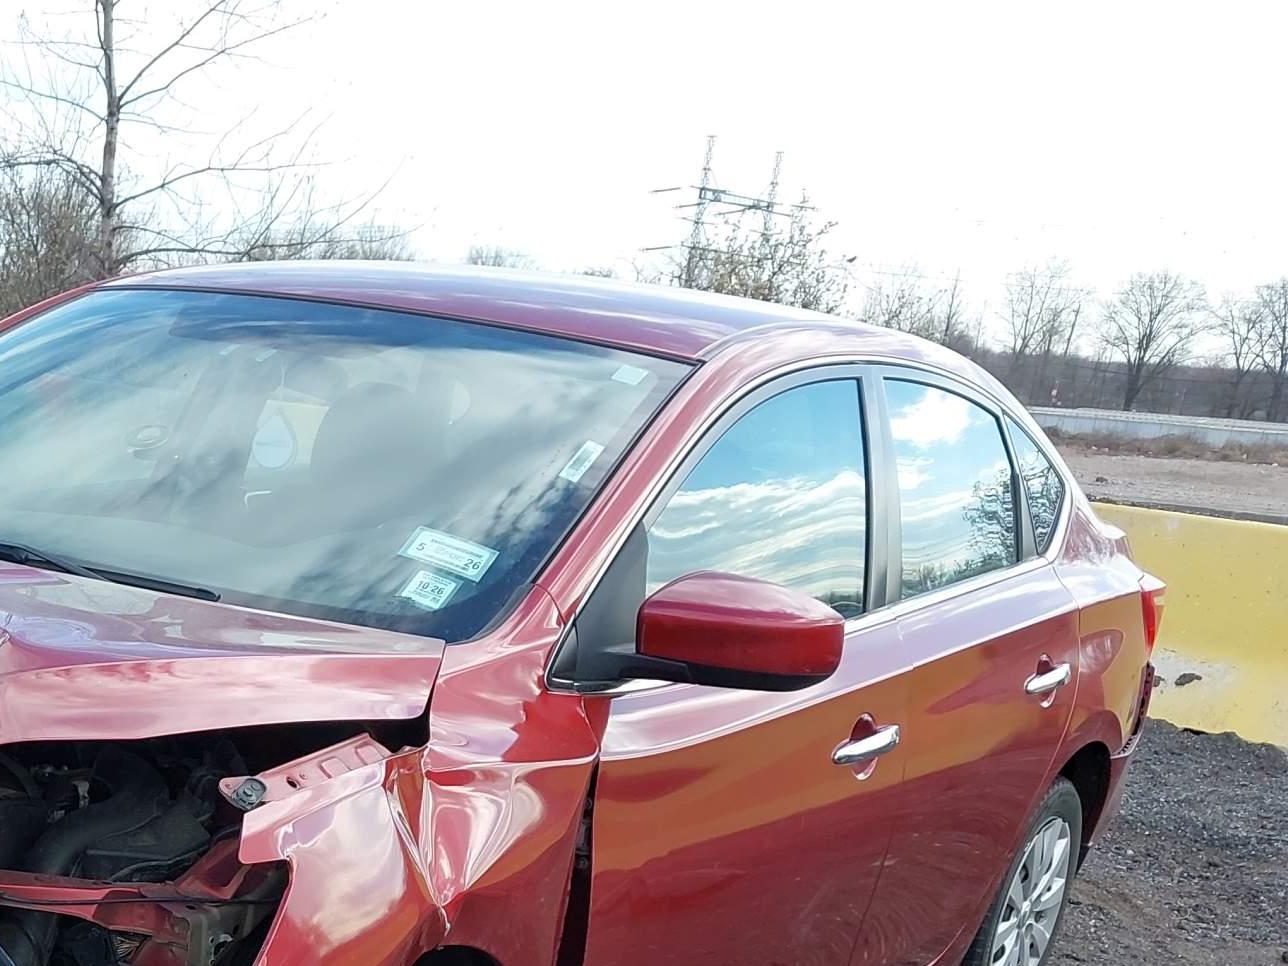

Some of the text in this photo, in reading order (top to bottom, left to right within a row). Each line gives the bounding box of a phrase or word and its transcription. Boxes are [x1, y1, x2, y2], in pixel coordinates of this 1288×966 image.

[416, 542, 427, 552] 5
[464, 558, 482, 570] 26
[417, 580, 429, 590] 10
[431, 585, 445, 595] 26
